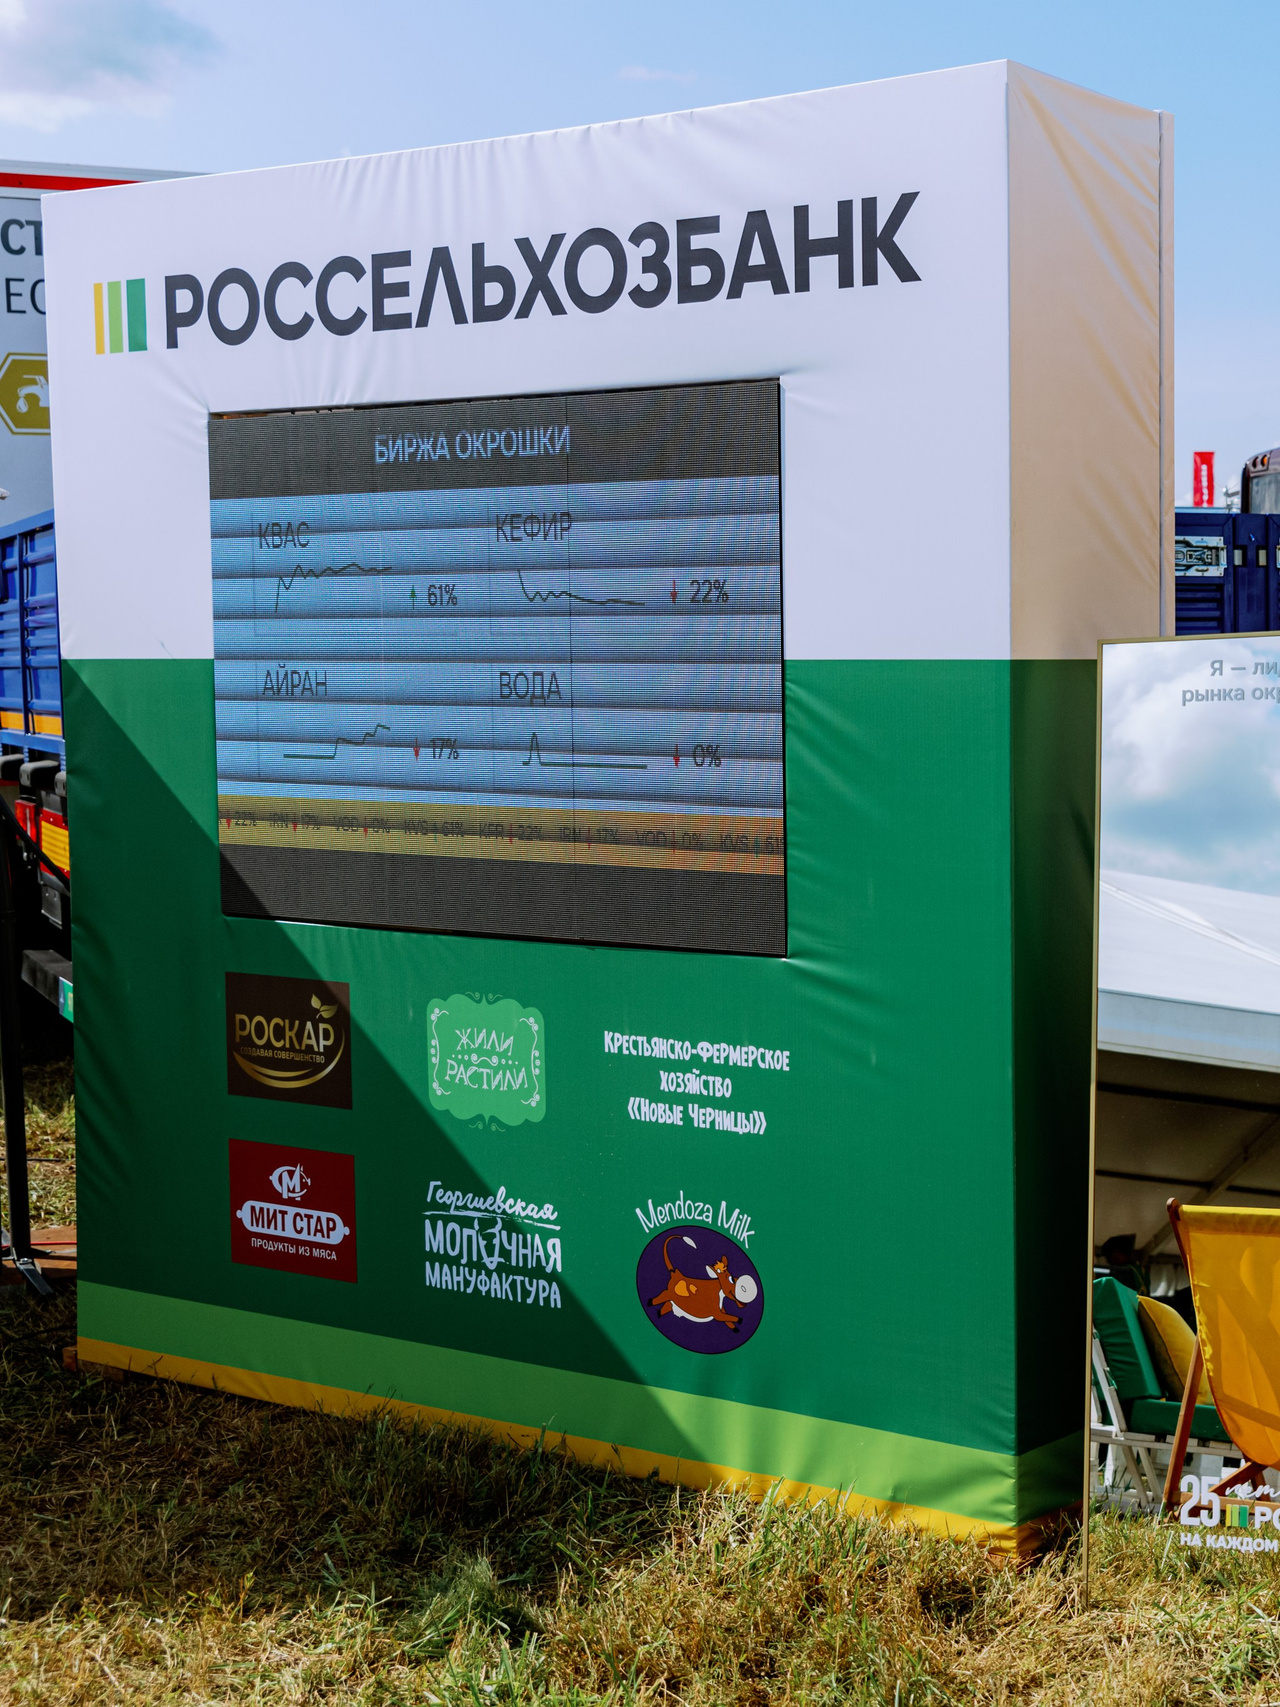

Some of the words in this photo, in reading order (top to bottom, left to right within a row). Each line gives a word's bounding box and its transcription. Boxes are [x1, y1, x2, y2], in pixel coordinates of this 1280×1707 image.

[165, 191, 922, 350] РОССЕЛЬХОЗБАНК
[374, 432, 451, 464] БИРЖА
[455, 425, 571, 459] ОКРОШКИ
[258, 521, 310, 550] КВАС
[496, 512, 572, 542] КЕФИР
[427, 584, 458, 606] 61%
[689, 580, 729, 604] 22%
[262, 663, 328, 697] АЙРАН
[1210, 659, 1224, 677] Я
[499, 671, 562, 703] ВОДА
[1181, 687, 1245, 707] рынка
[429, 738, 459, 760] 17%
[692, 744, 722, 768] 0%
[235, 1013, 335, 1053] РОСКАР
[455, 1027, 514, 1056] ЖИЛИ
[240, 1046, 273, 1058] СОЗДАВАЯ
[273, 1050, 325, 1064] СОВЕРШЕНСТВО
[444, 1058, 528, 1091] РАСТИЛИ
[659, 1068, 732, 1098] ХОЗЯЙСТВО
[426, 1180, 558, 1221] Георгиевская
[250, 1204, 288, 1232] МИТ
[292, 1211, 337, 1239] СТАР
[635, 1190, 713, 1233] Mendoza
[718, 1200, 755, 1249] Milk
[251, 1237, 296, 1254] ПРОДУКТЫ
[298, 1245, 310, 1256] ИЗ
[312, 1247, 337, 1260] МЯСА
[425, 1261, 562, 1309] МАНУФАКТУРА
[1180, 1474, 1221, 1528] 25
[1180, 1532, 1202, 1547] НА
[1206, 1534, 1279, 1554] КАЖДОМ
